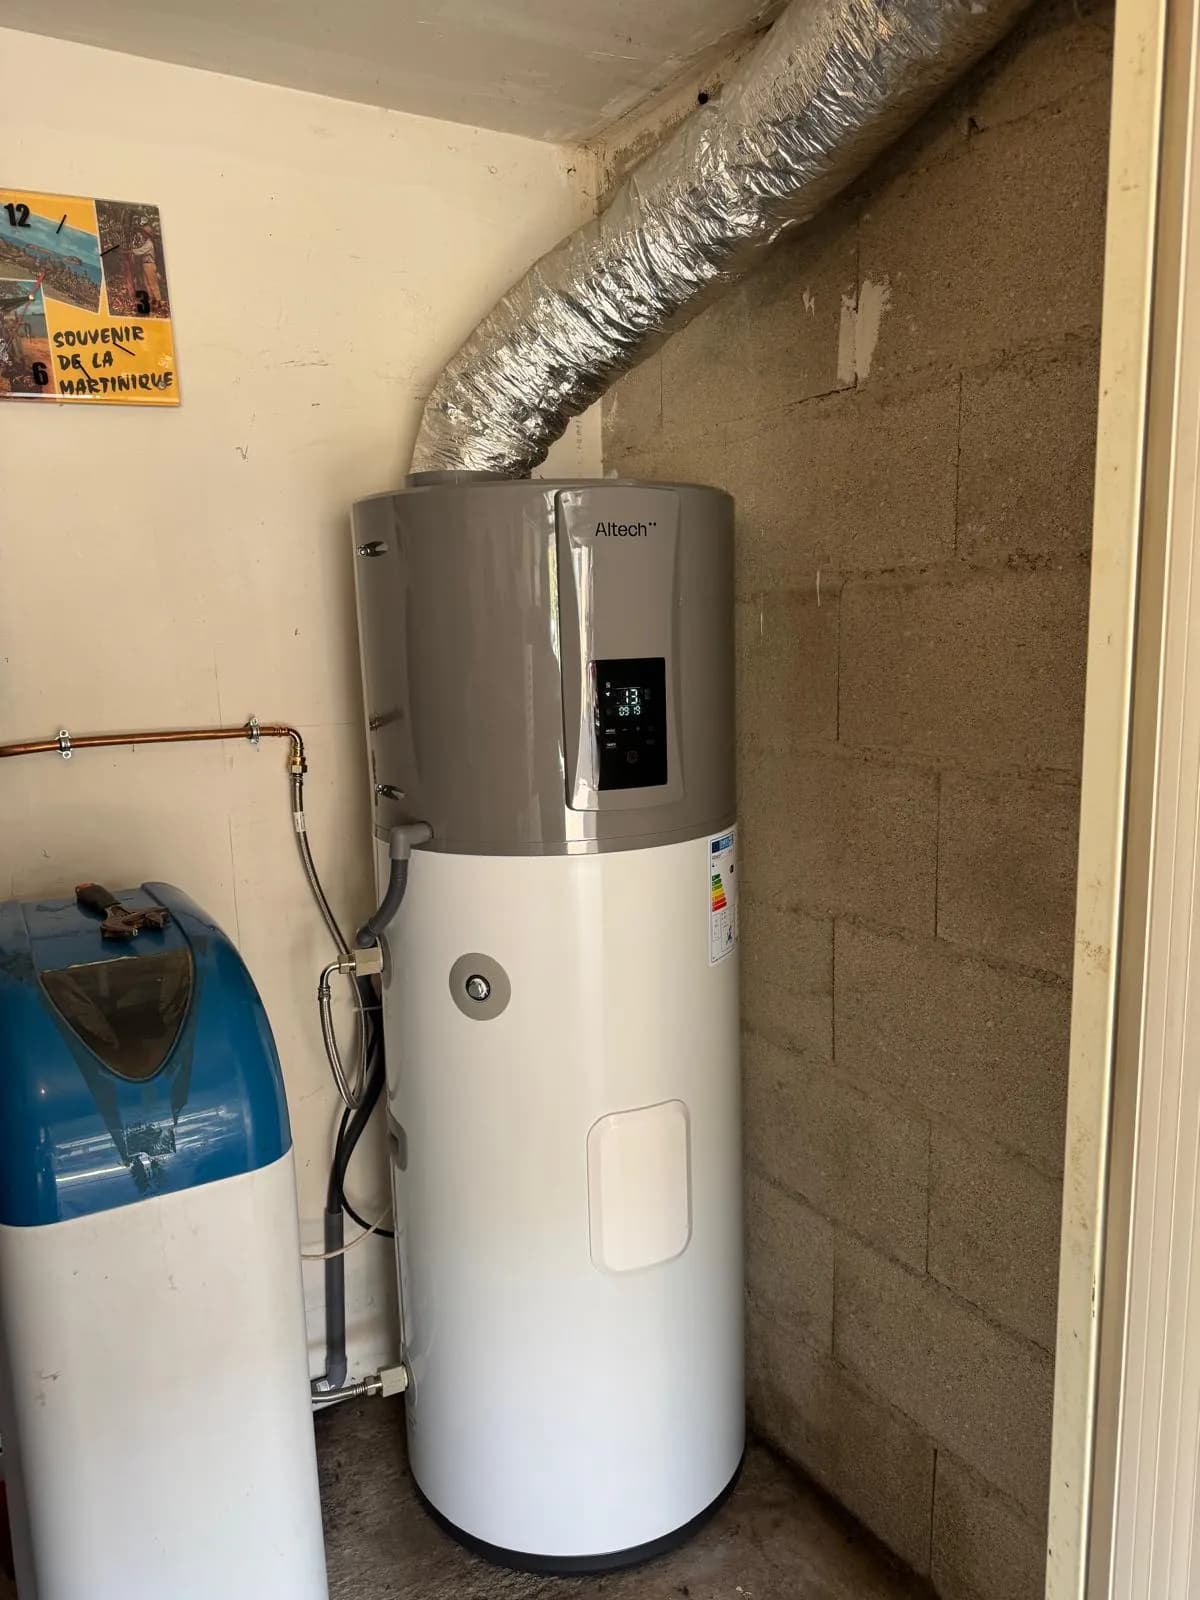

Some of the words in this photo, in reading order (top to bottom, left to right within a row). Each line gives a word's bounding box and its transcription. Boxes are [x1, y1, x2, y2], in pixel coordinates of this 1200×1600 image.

[4, 203, 31, 228] 12
[135, 290, 151, 314] 3
[53, 325, 145, 348] SOUVENIR
[57, 353, 81, 370] DE
[92, 350, 114, 369] LA
[32, 361, 49, 386] 6
[59, 371, 173, 395] MARTINIQUE
[595, 522, 647, 537] Altech
